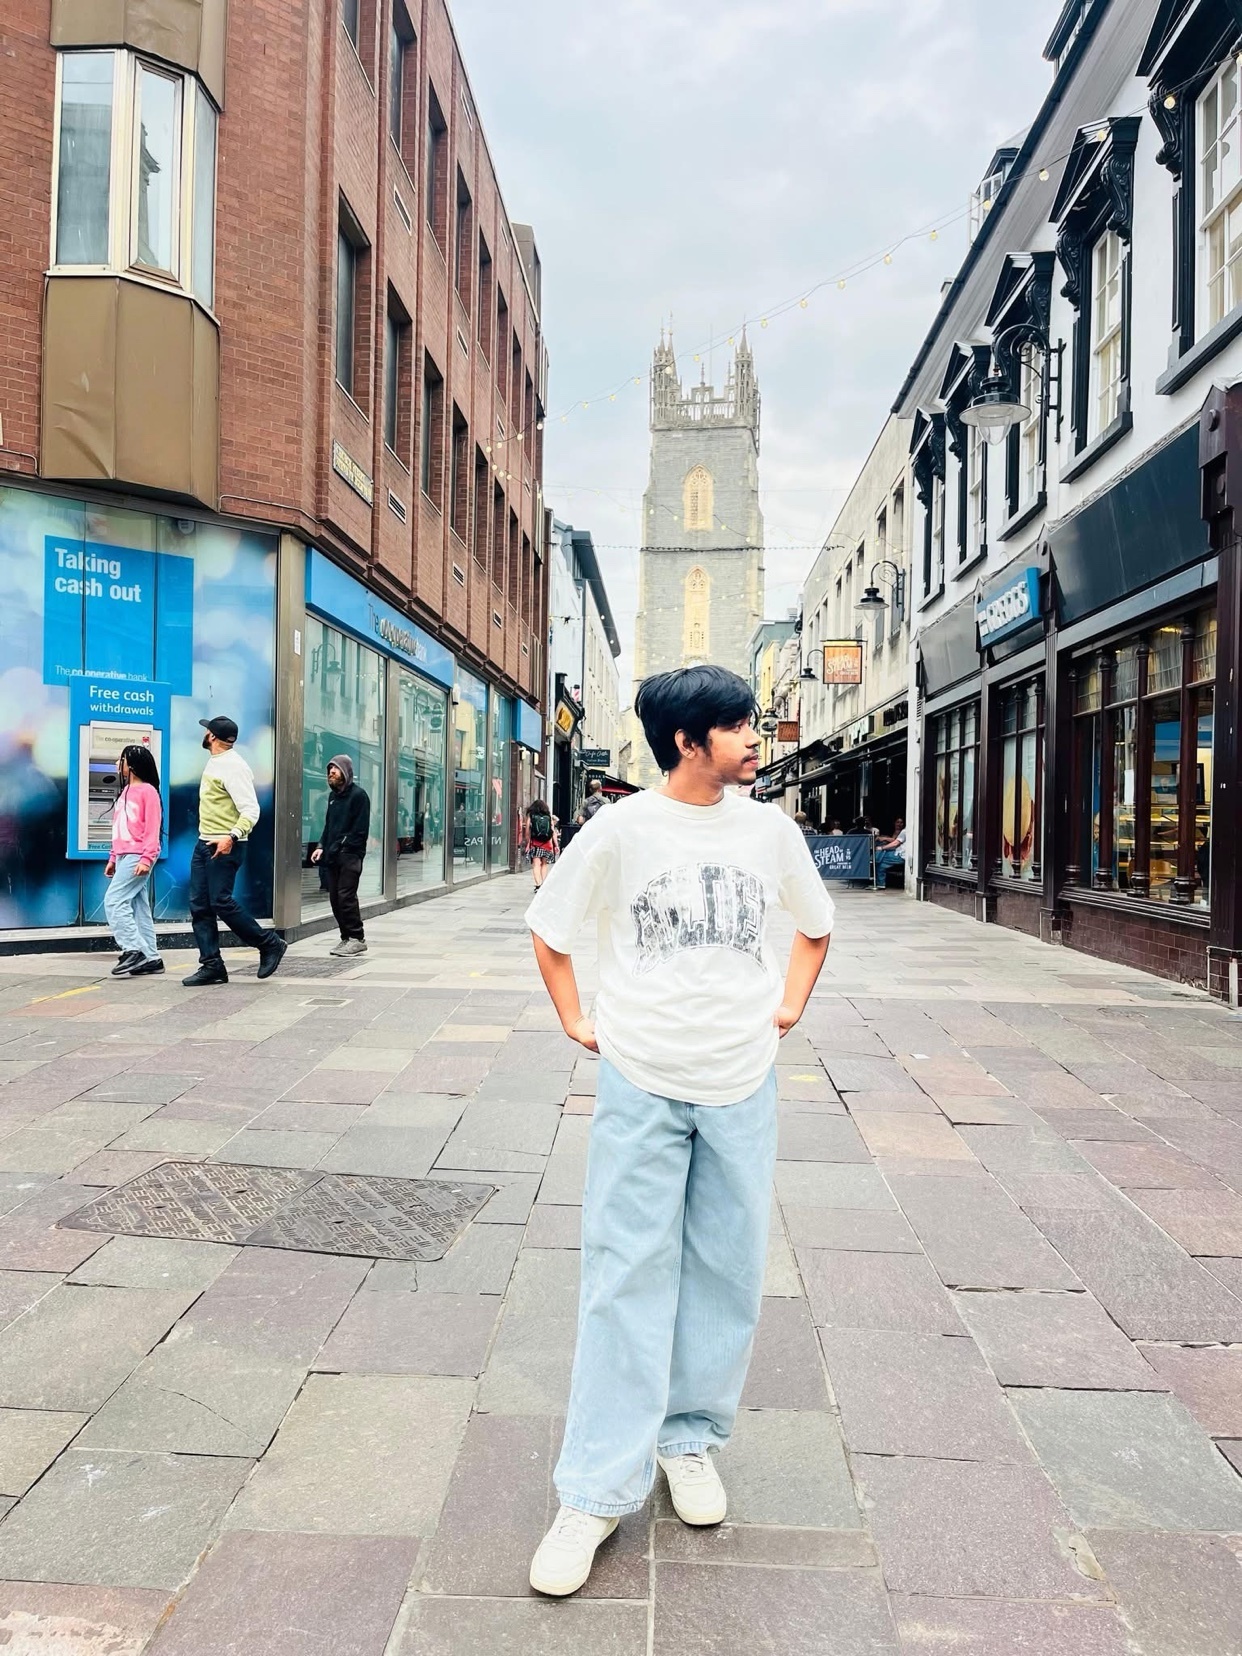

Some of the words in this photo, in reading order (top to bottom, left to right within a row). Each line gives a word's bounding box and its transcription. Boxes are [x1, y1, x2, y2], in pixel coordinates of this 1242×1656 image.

[55, 547, 121, 579] Taking
[55, 577, 103, 597] cash
[110, 585, 141, 602] out
[986, 581, 1029, 632] GREGGS
[55, 665, 70, 675] The
[71, 669, 127, 679] cooperative
[128, 673, 147, 681] bank
[90, 686, 120, 699] Free
[123, 690, 154, 703] cash
[90, 703, 154, 716] withdrawals
[820, 845, 840, 856] HEAD
[815, 853, 844, 868] STEAM
